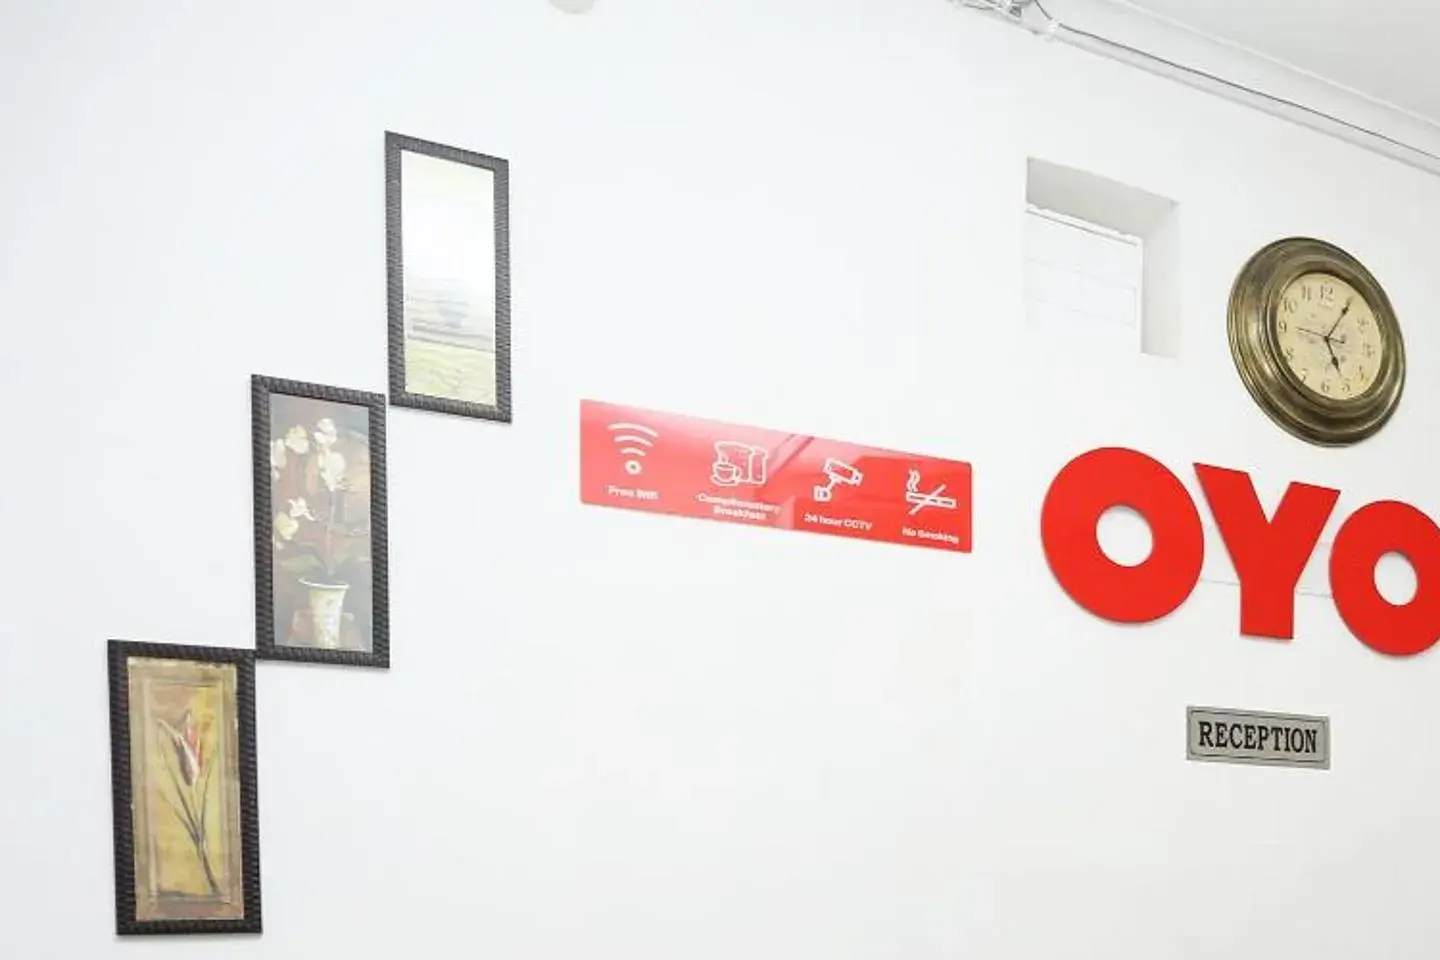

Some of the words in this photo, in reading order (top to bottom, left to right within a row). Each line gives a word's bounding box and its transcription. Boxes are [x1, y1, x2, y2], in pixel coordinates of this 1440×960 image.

[1320, 285, 1334, 302] 12
[1283, 297, 1298, 313] 10
[1278, 320, 1287, 332] 9
[1320, 381, 1330, 393] 6
[608, 485, 634, 498] Free
[804, 513, 818, 524] 24
[819, 515, 842, 527] hour
[844, 518, 872, 531] CCTV
[902, 526, 917, 537] No
[1198, 721, 1317, 753] RECEPTION
